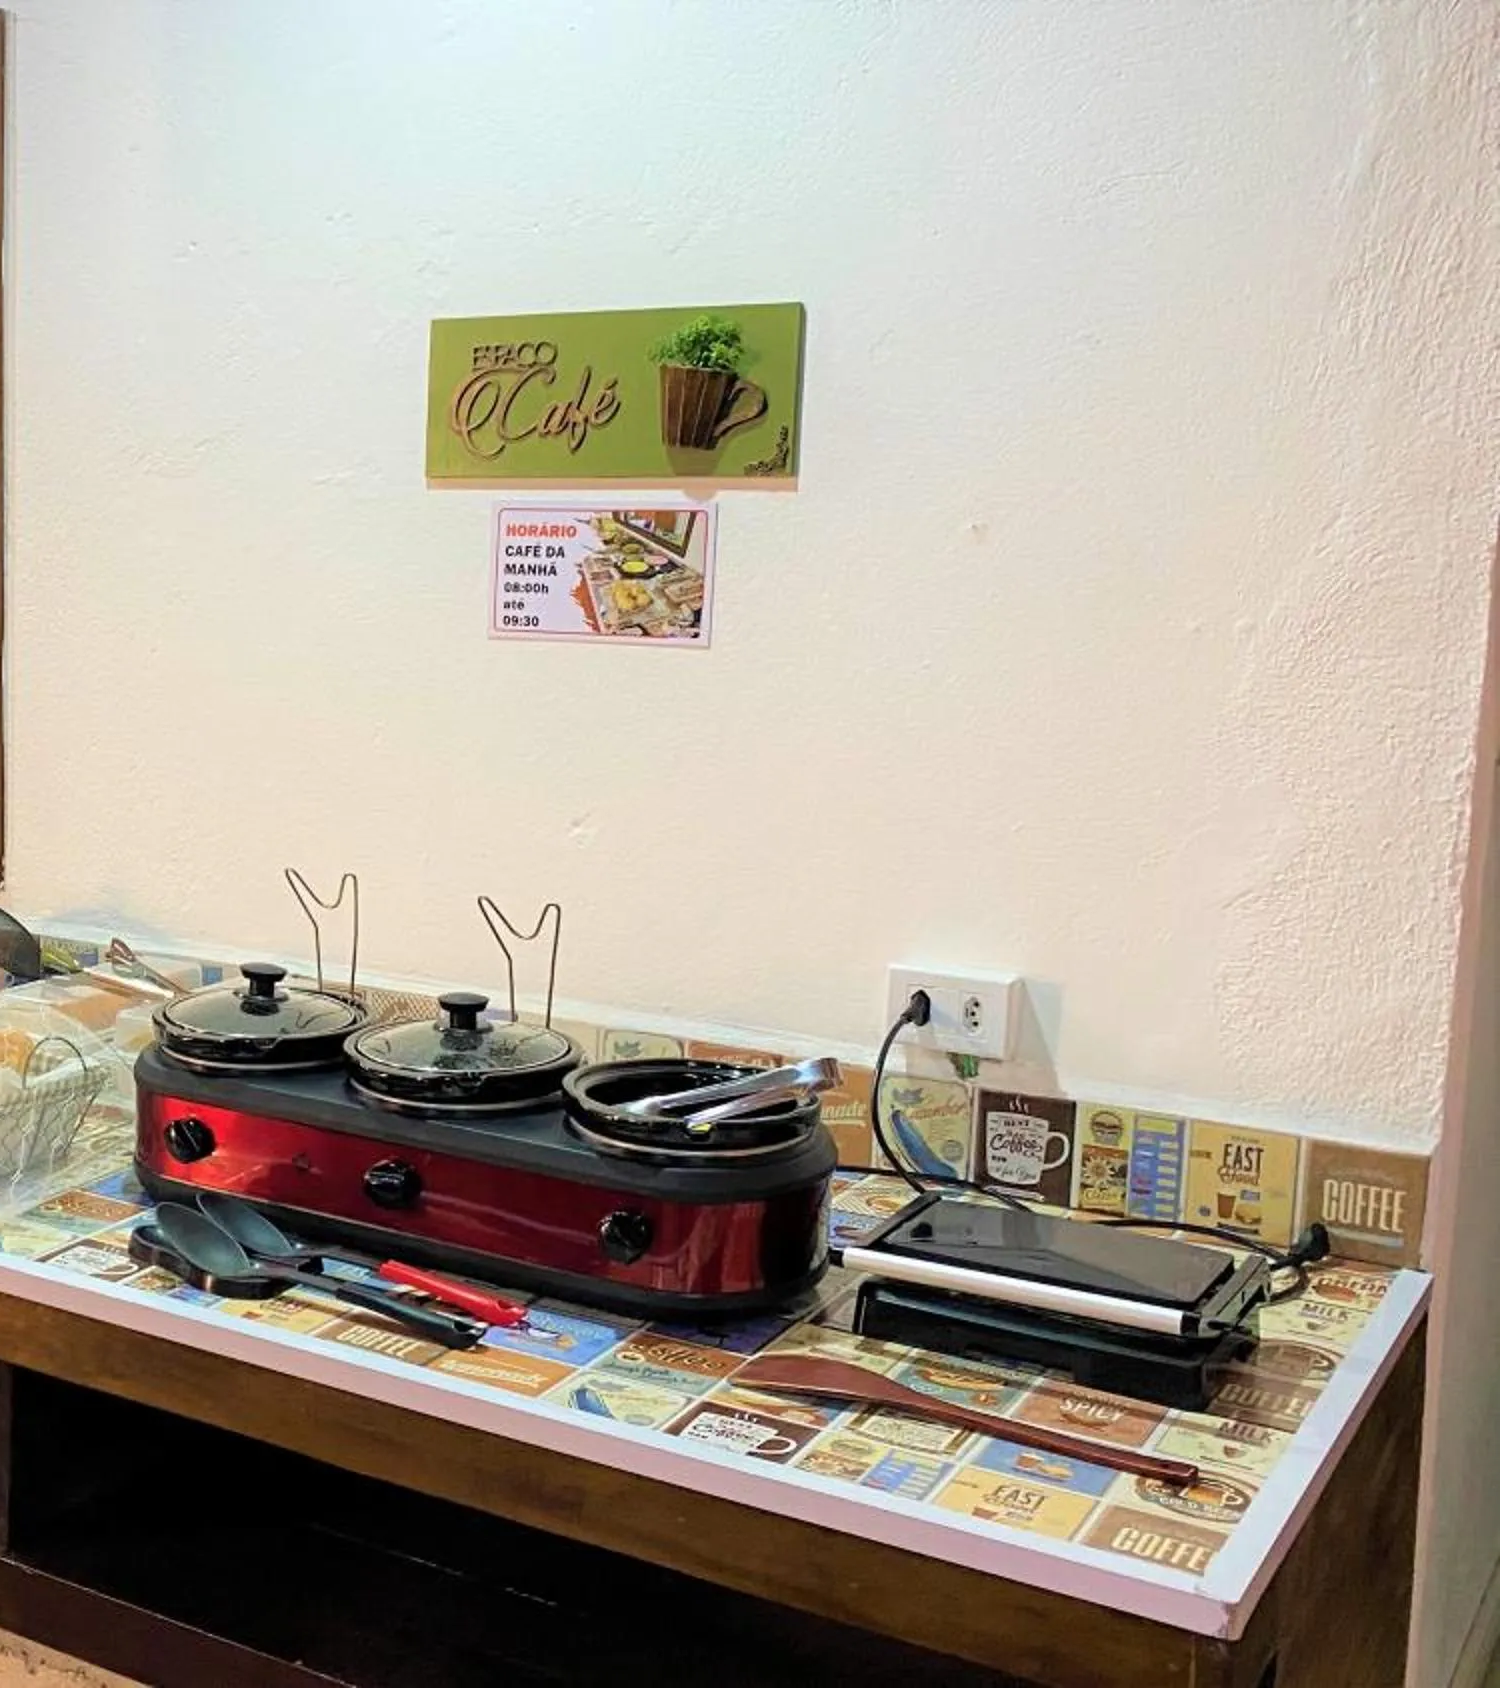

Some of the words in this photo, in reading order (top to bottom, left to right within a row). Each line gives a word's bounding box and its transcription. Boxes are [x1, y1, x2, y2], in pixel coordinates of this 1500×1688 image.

[505, 519, 578, 538] HORÁRIO
[504, 540, 543, 558] CAFÉ
[545, 545, 566, 559] DA
[503, 561, 558, 577] MANHÃ
[503, 582, 549, 595] 08:00h
[503, 598, 525, 611] até
[503, 615, 540, 627] 09:30
[1322, 1178, 1406, 1234] COFFEE
[1059, 1396, 1126, 1422] SPICY
[1218, 1420, 1274, 1445] MILK
